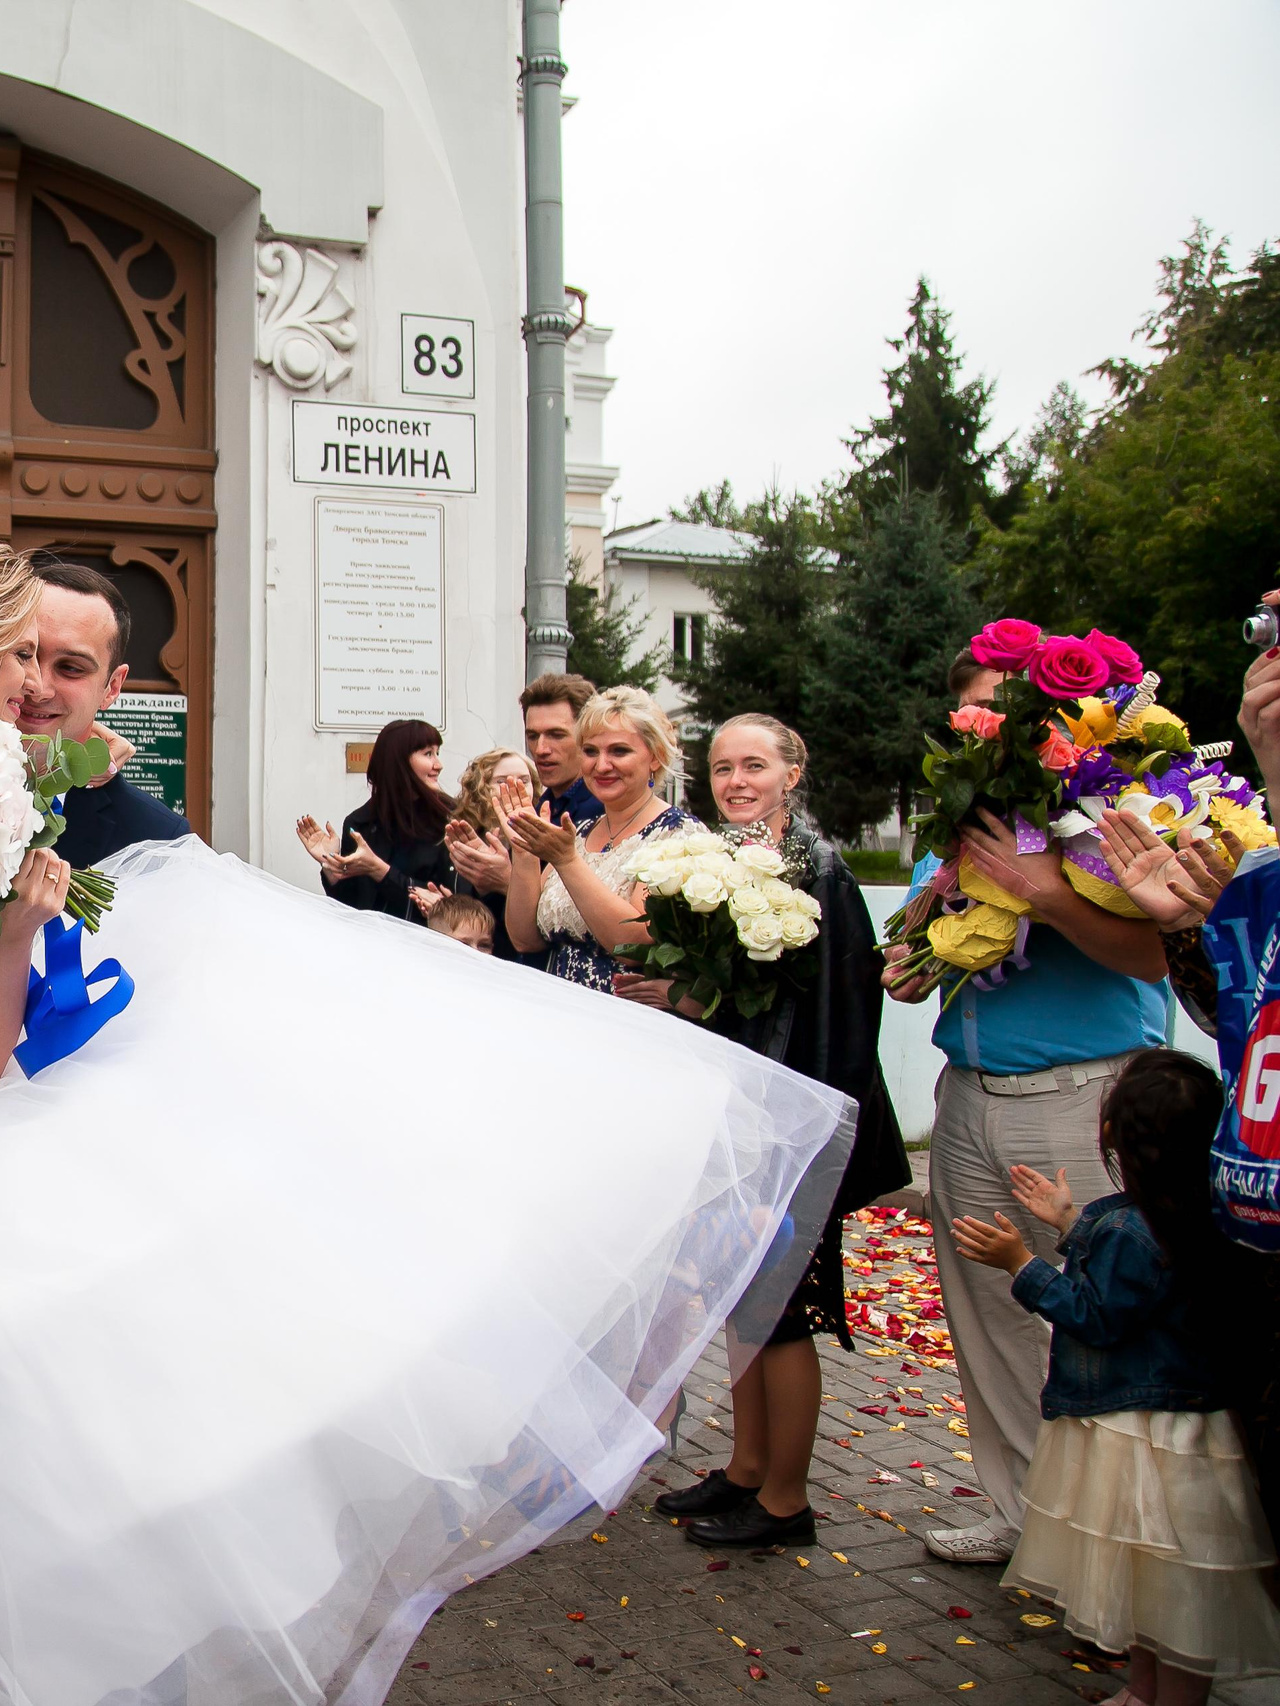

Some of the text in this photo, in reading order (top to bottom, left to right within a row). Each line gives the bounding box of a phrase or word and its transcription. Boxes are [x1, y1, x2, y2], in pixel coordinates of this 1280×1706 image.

[413, 333, 464, 379] 83
[337, 415, 431, 437] проспект
[321, 442, 451, 480] ЛЕНИНА
[151, 712, 173, 721] брака
[112, 720, 143, 728] чистоты
[151, 722, 177, 730] городе
[139, 729, 153, 737] при
